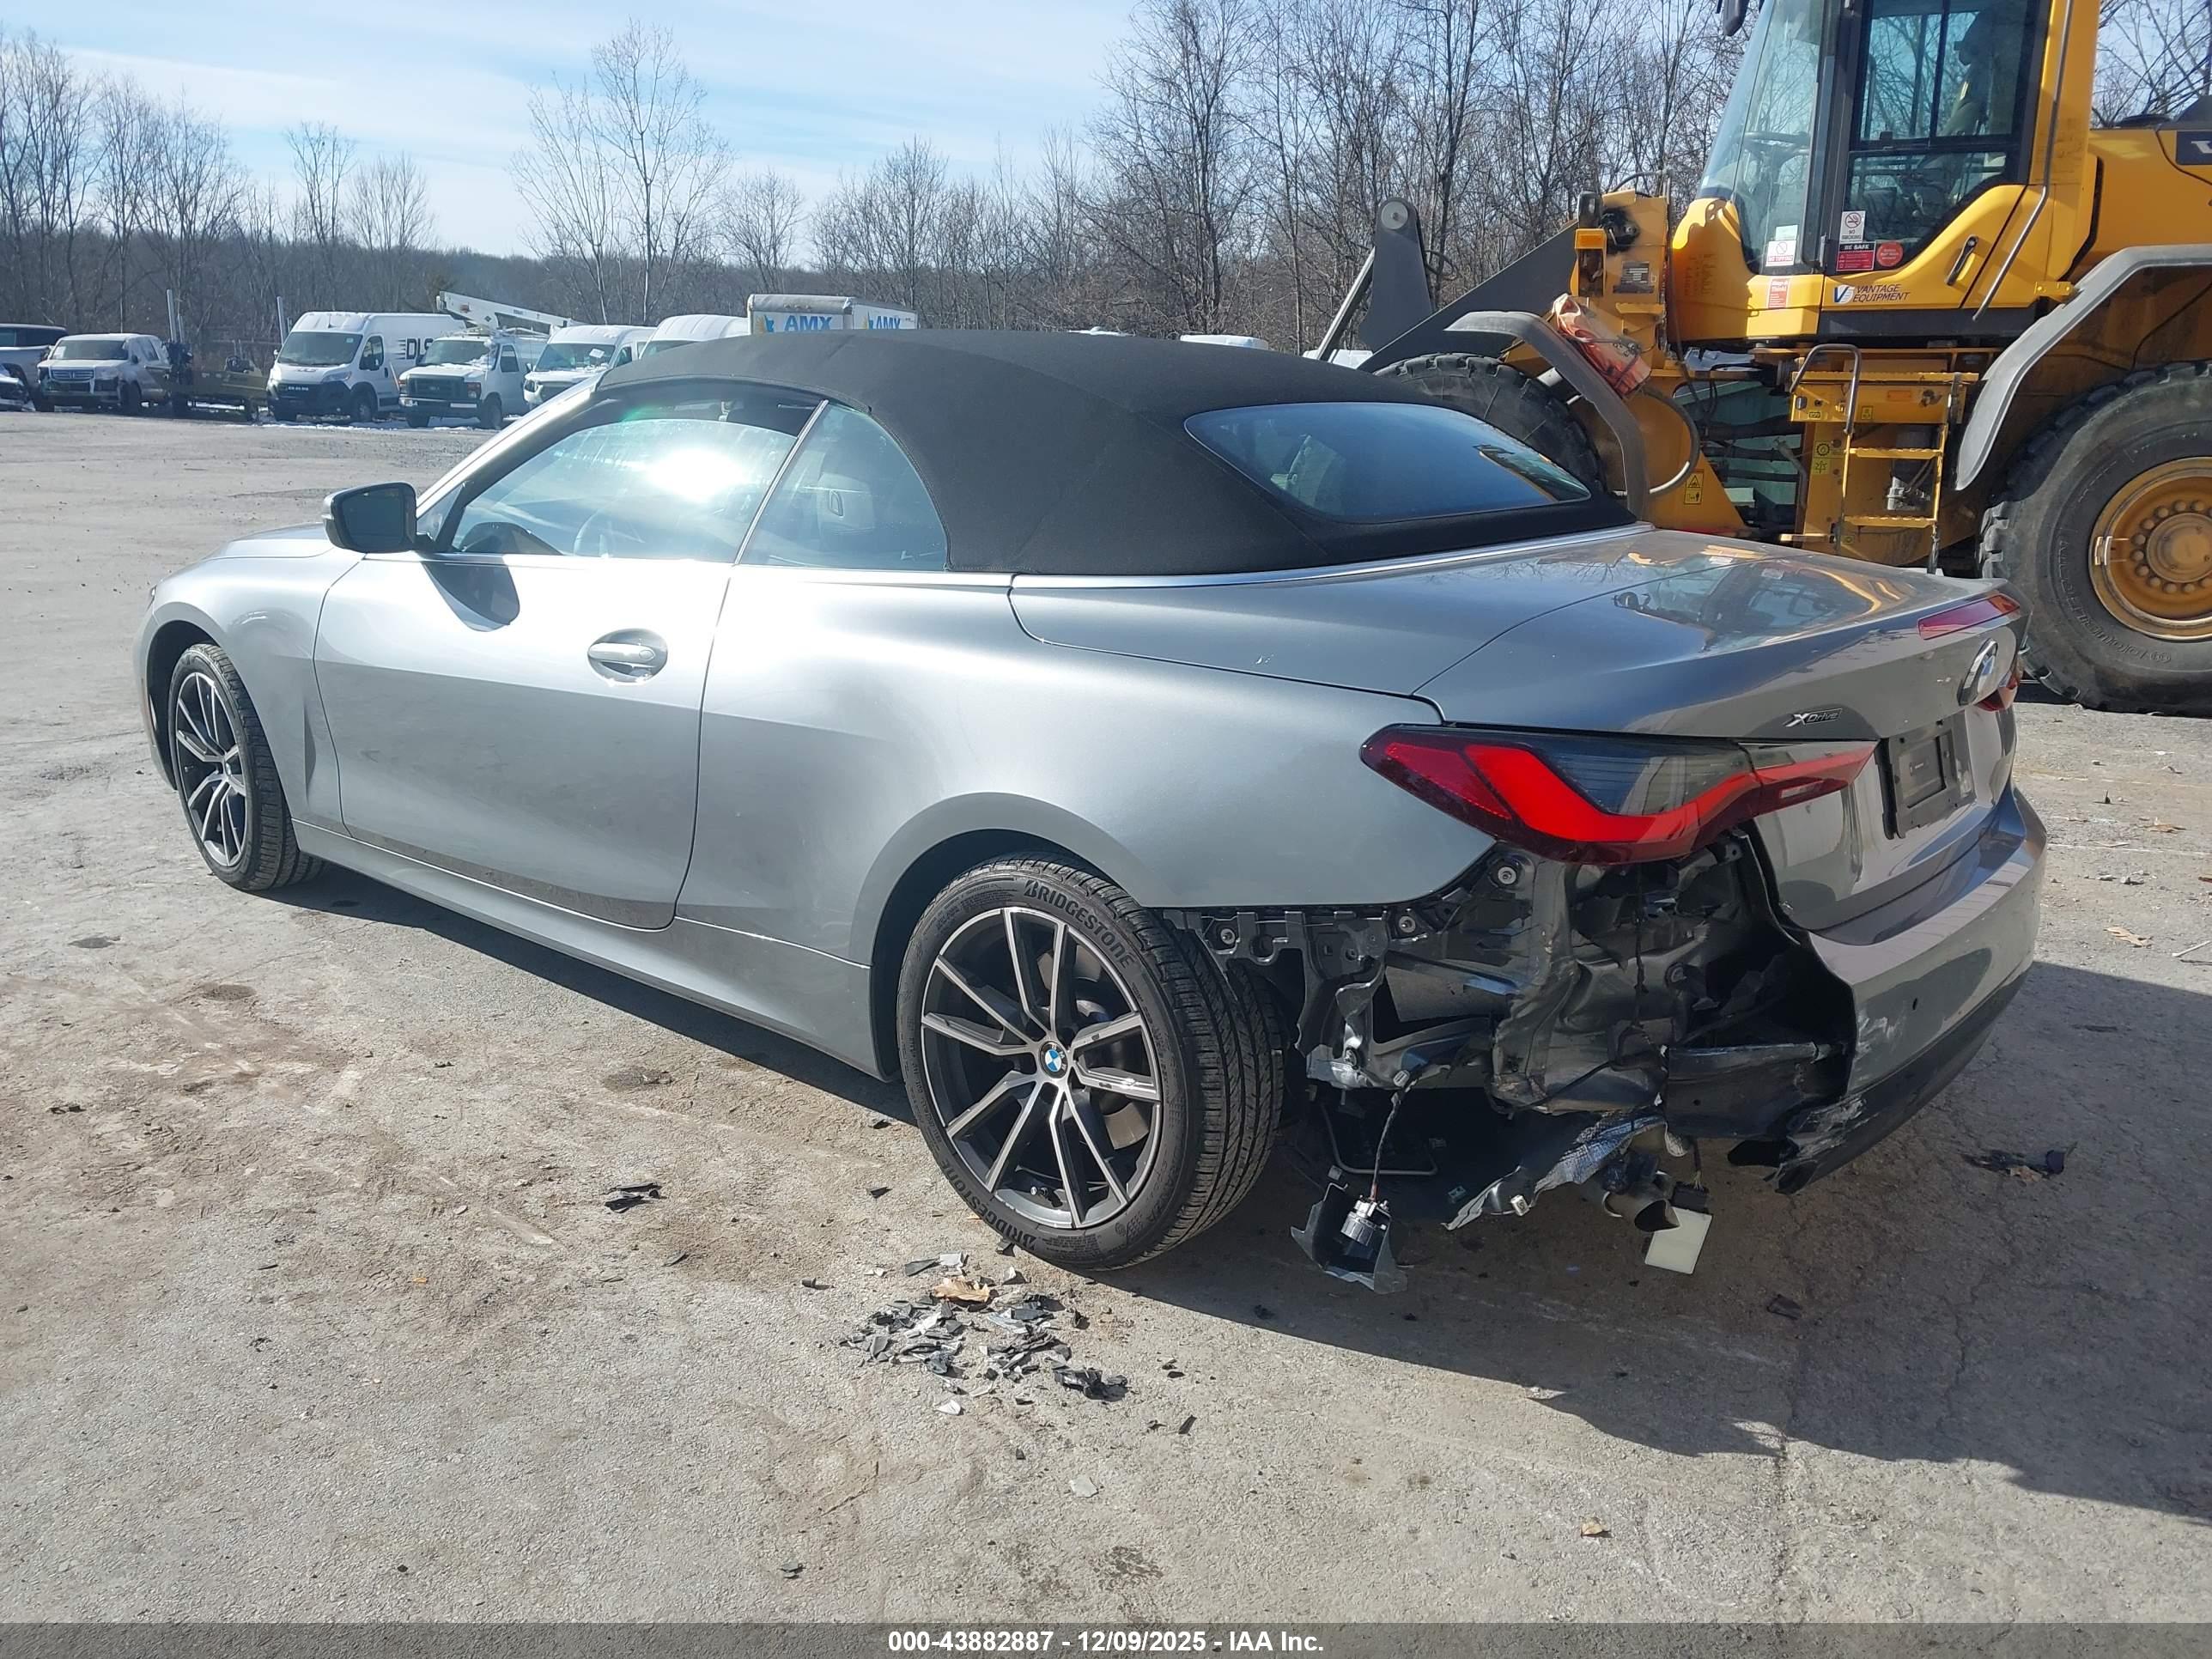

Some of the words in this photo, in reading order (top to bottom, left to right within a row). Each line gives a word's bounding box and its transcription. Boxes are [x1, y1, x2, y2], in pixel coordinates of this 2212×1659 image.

[1853, 292, 1911, 302] EQUIPMENT
[1856, 283, 1901, 293] VANTAGE
[783, 314, 833, 332] AMX
[1024, 879, 1135, 969] BRIDGESTONE
[941, 1158, 1037, 1251] BRIDGESTONE
